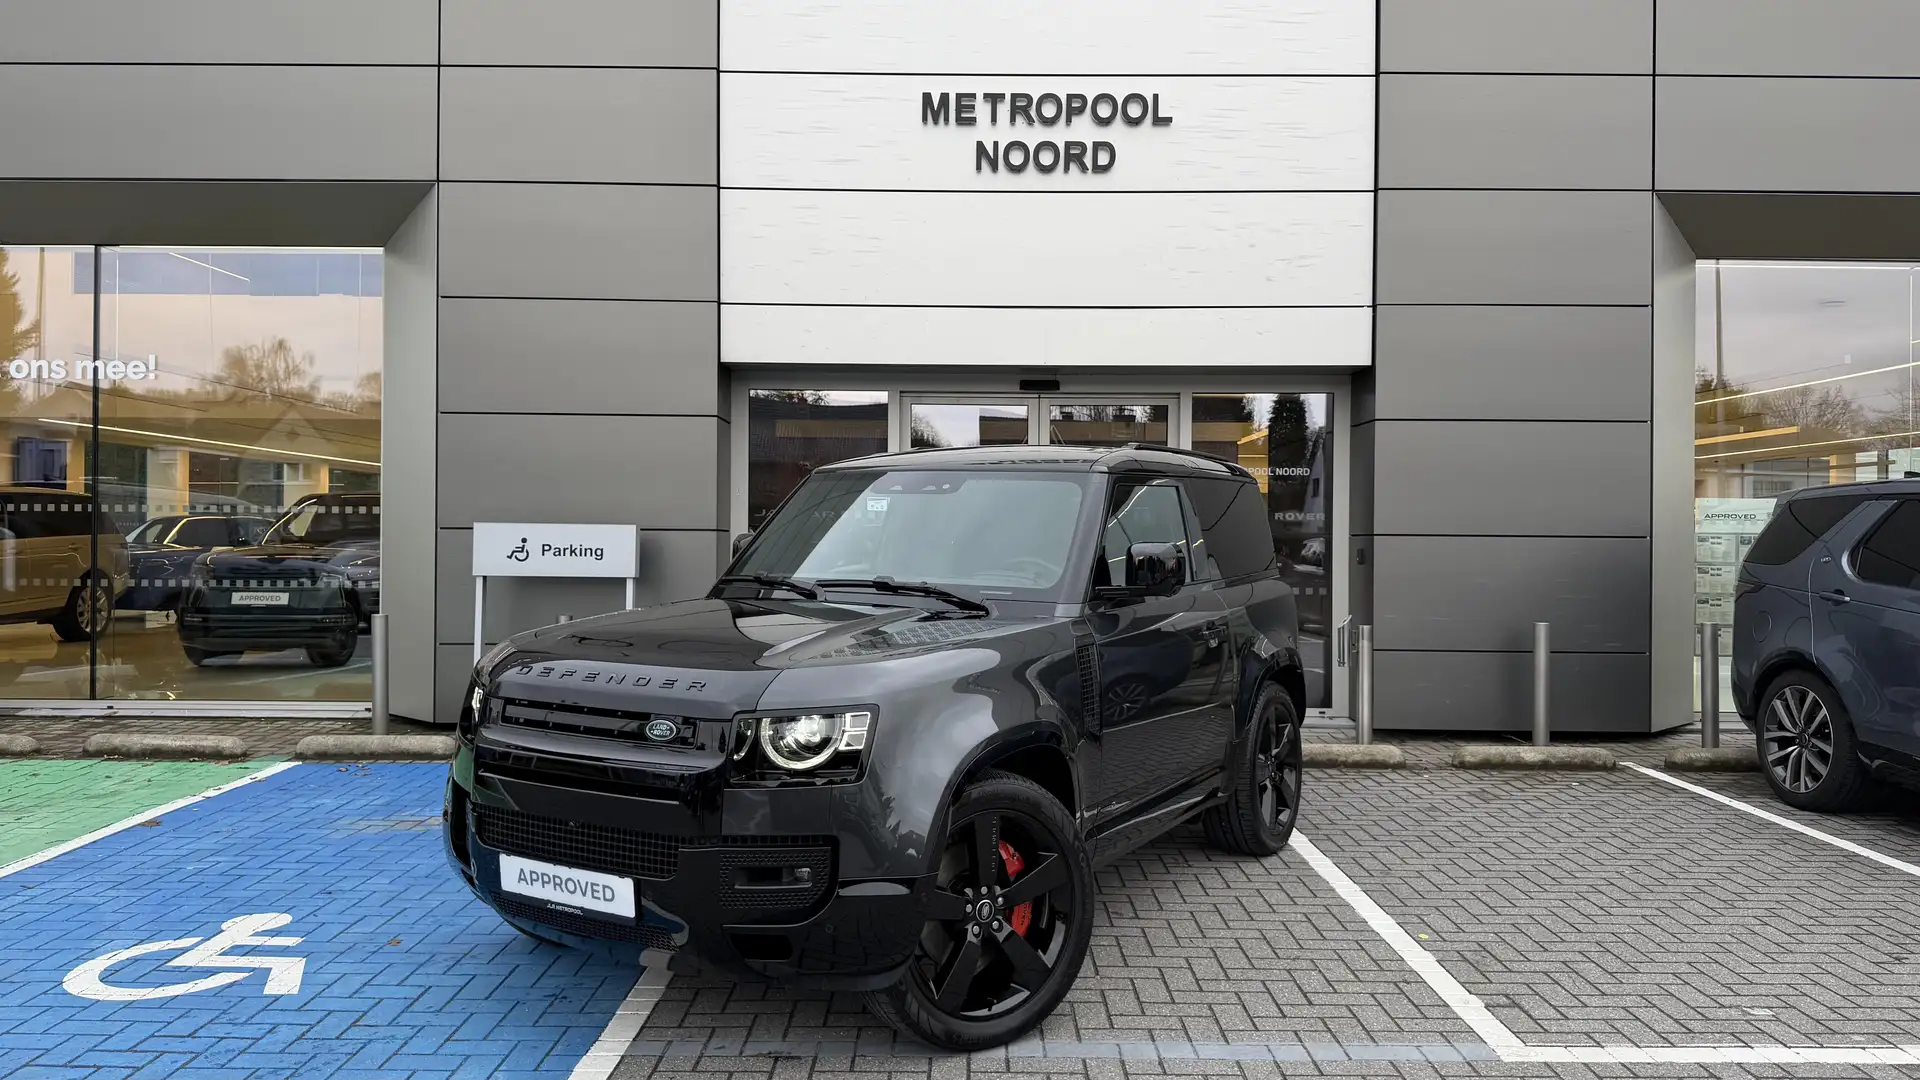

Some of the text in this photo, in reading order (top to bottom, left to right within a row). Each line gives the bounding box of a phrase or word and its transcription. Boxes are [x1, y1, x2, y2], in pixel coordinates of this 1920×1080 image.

[921, 92, 1173, 126] METROPOOL
[975, 140, 1117, 174] NOORD
[9, 354, 157, 381] ons mee!
[1276, 467, 1311, 476] NOORD
[1274, 512, 1326, 521] ROVER
[541, 543, 604, 561] Parking
[515, 665, 707, 692] DEFENDER
[517, 867, 616, 903] APPROVED
